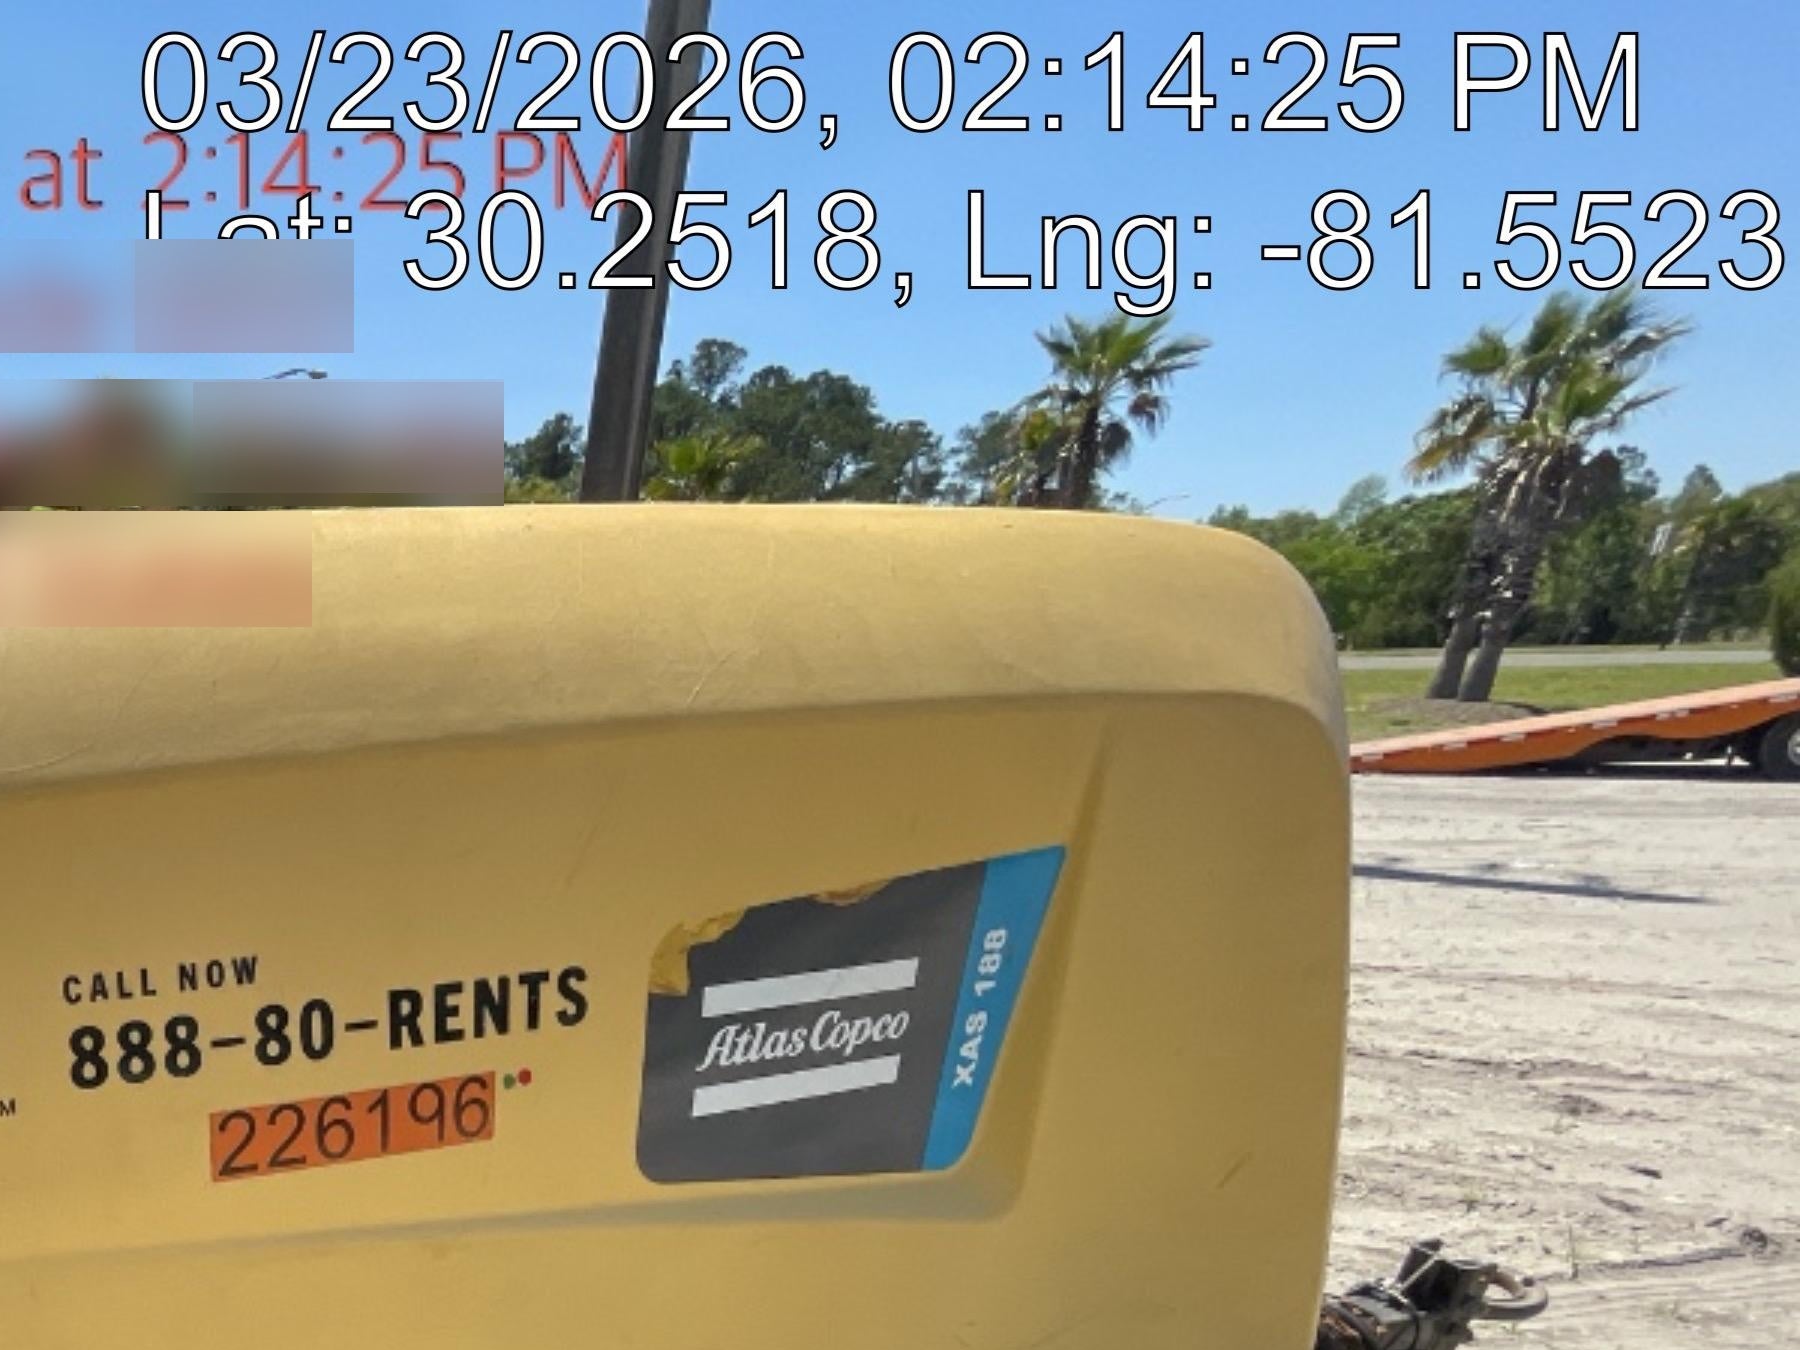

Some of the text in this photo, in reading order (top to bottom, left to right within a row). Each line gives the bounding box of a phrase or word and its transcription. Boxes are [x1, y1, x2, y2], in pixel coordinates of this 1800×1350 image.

[61, 954, 259, 1005] CALL NOW
[68, 966, 590, 1090] 888-80-RENTS
[953, 928, 1008, 1090] XAS 188
[216, 1074, 490, 1179] 226196
